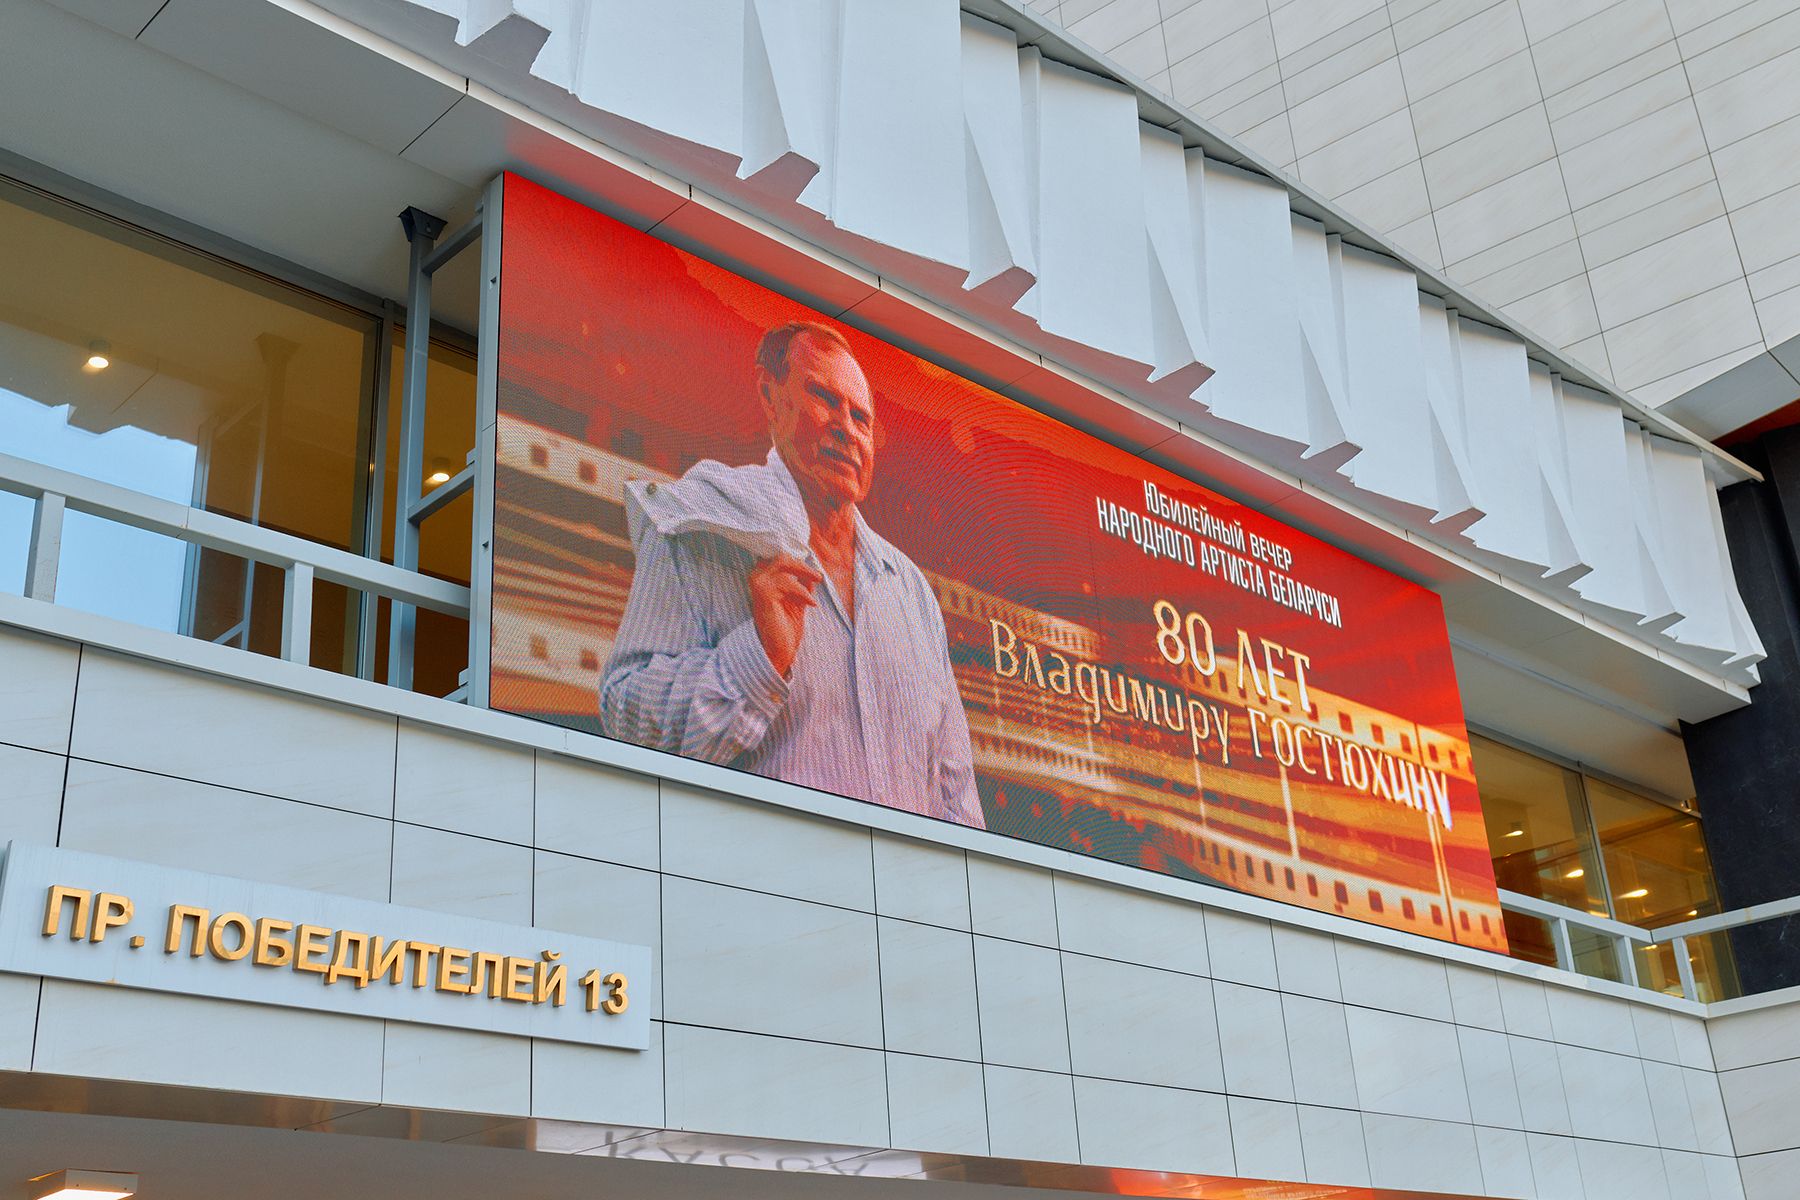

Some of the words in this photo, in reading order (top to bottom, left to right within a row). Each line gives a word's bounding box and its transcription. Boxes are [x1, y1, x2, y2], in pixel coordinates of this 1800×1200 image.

[1096, 496, 1196, 567] НАРОДНОГО
[1200, 541, 1268, 598] АРТИСТА
[1269, 569, 1342, 628] БЕЛАРУСИ
[1249, 532, 1293, 571] ВЕЧЕР
[989, 618, 1230, 765] Владимиру
[1153, 599, 1217, 677] 80
[1236, 628, 1312, 713] ЛЕТ
[41, 885, 146, 948] ПР.
[164, 903, 568, 1007] ПОБЕДИТЕЛЕЙ
[577, 967, 629, 1016] 13
